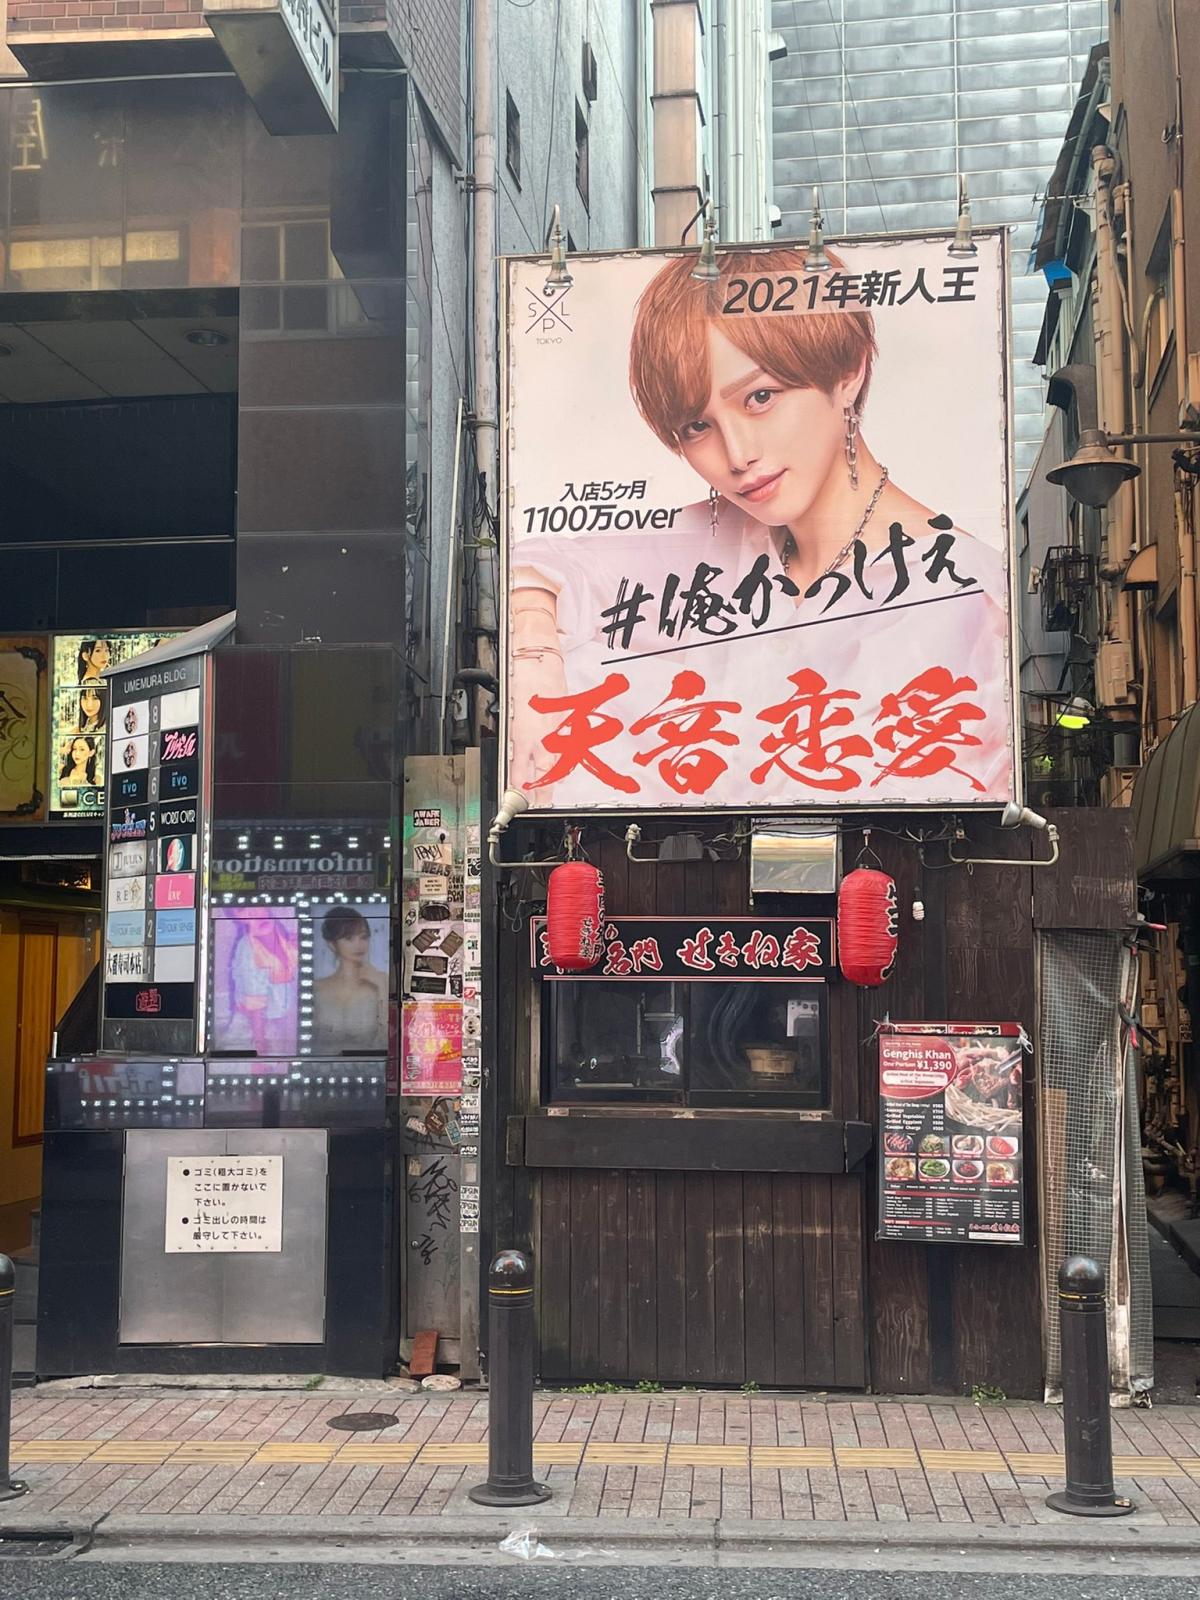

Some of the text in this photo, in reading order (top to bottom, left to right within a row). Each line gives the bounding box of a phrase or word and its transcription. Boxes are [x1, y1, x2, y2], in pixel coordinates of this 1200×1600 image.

[722, 266, 980, 314] 2021年新人王
[536, 337, 564, 345] TOKYO
[523, 504, 683, 533] 1100万over
[124, 668, 186, 694] UMEMURA BLDG
[152, 705, 158, 724] 8
[152, 741, 158, 759] 7
[151, 777, 157, 795] 6
[149, 811, 156, 831] 5
[148, 919, 153, 938] 2
[676, 926, 824, 972] せきね家
[883, 1049, 951, 1060] Genghis Khan
[917, 1061, 952, 1071] ¥1,390
[194, 1167, 268, 1177] ゴミ(粗大ゴミ)を
[194, 1182, 268, 1192] ここに置かないで
[194, 1198, 226, 1207] 下さい。
[193, 1215, 267, 1225] ゴミ出しの時間は
[193, 1231, 262, 1240] 厳守して下さい。
